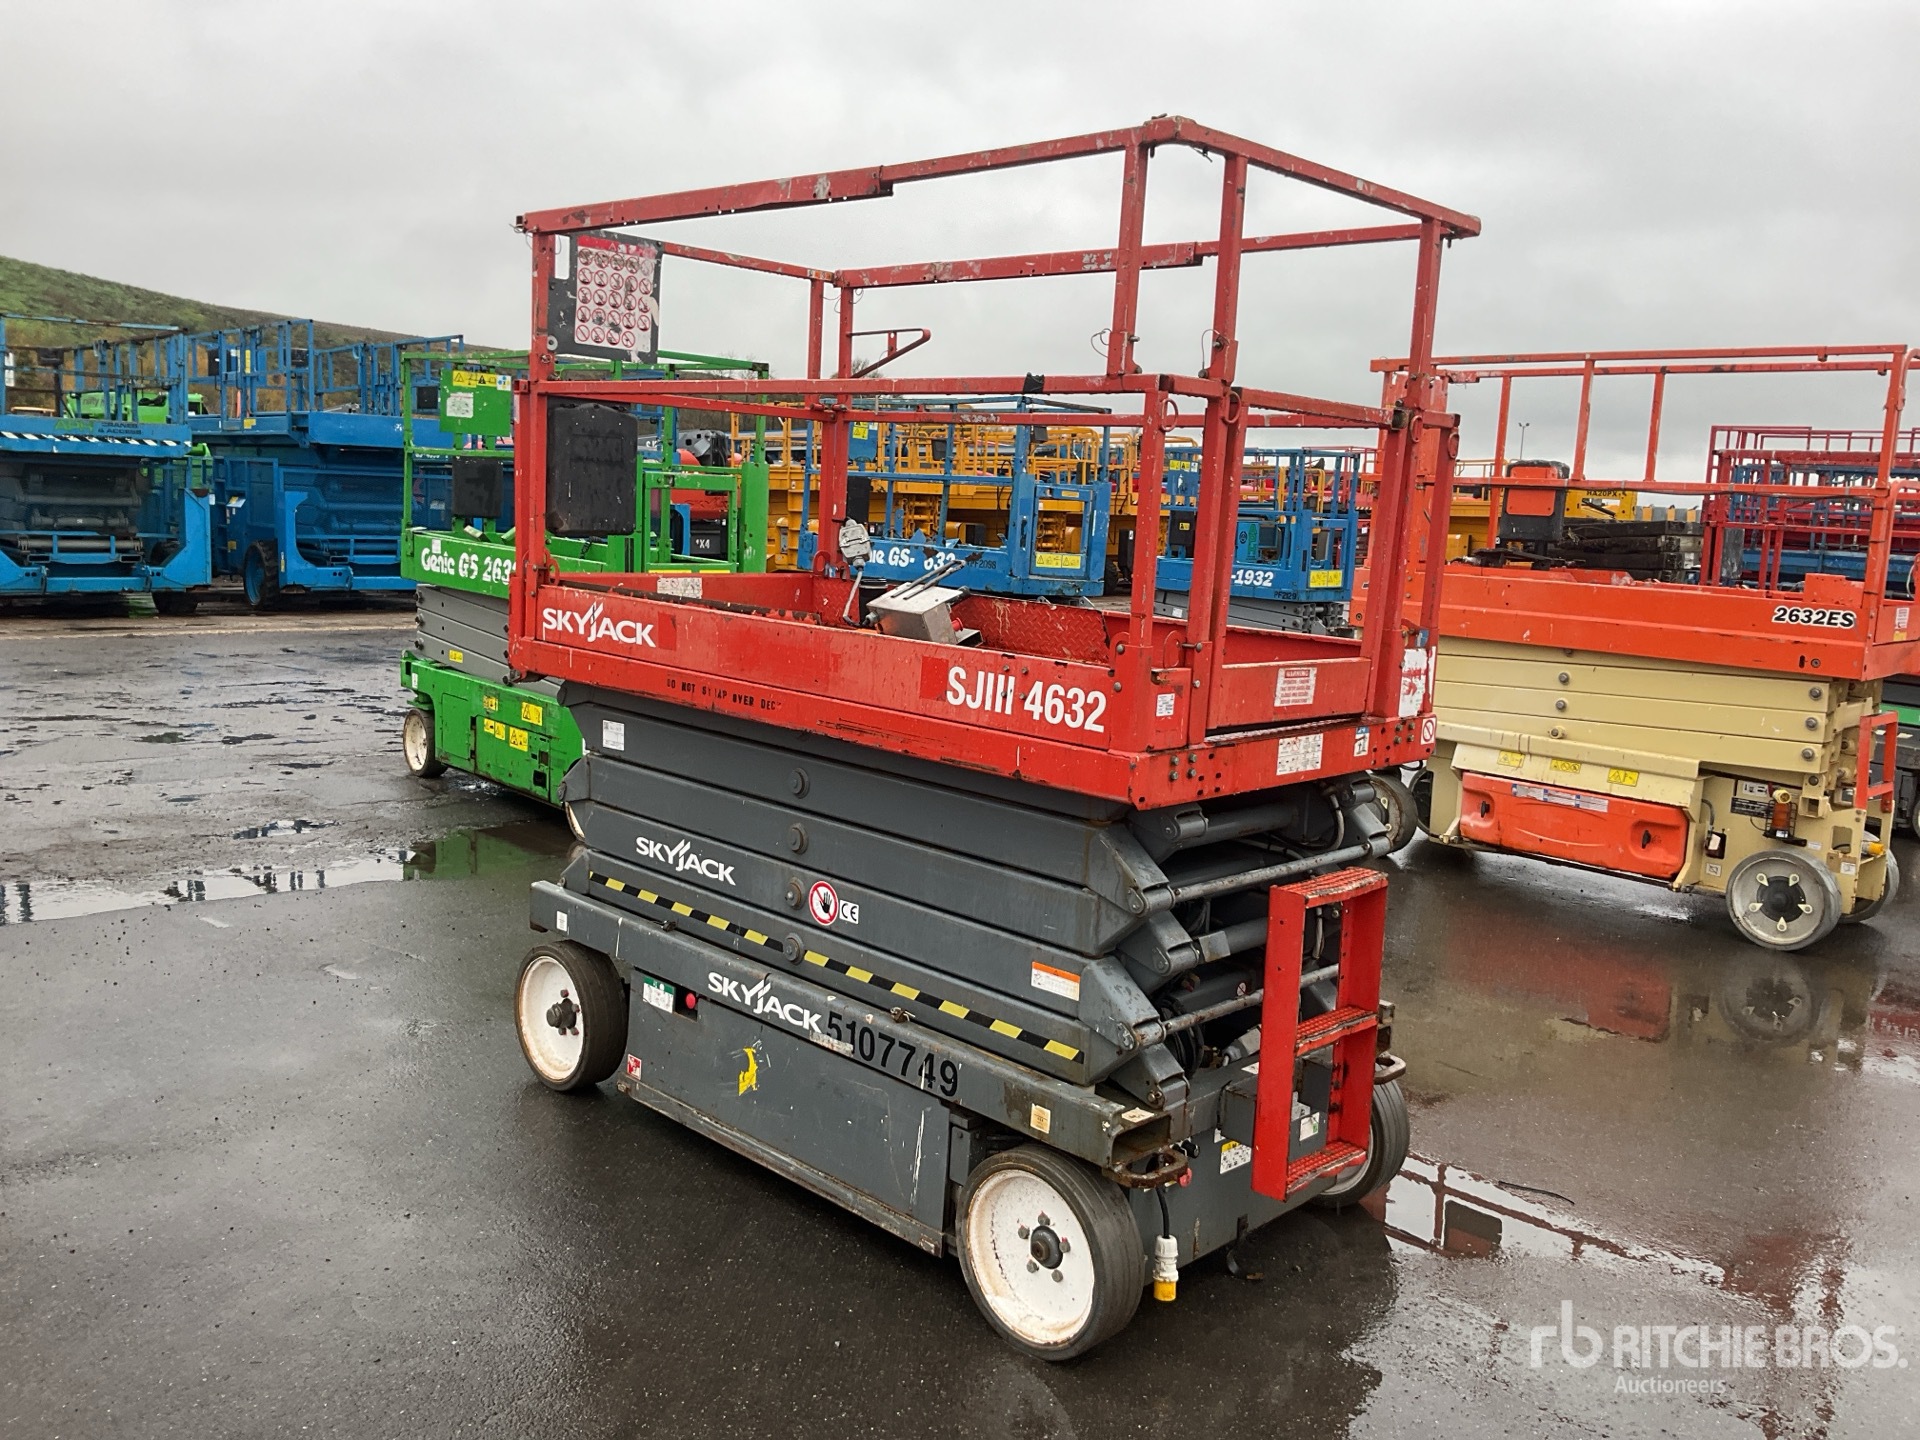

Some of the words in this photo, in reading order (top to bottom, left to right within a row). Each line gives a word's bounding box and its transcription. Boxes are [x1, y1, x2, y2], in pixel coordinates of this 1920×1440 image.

[482, 555, 517, 586] 263
[1231, 569, 1274, 588] -1932
[542, 601, 656, 648] SKYJACK
[1772, 605, 1857, 629] 2632ES
[732, 693, 755, 707] OVER
[1023, 680, 1107, 733] 4632
[635, 836, 737, 886] SKYJACK
[707, 971, 823, 1034] SKYJACK
[826, 1010, 958, 1097] 5107749
